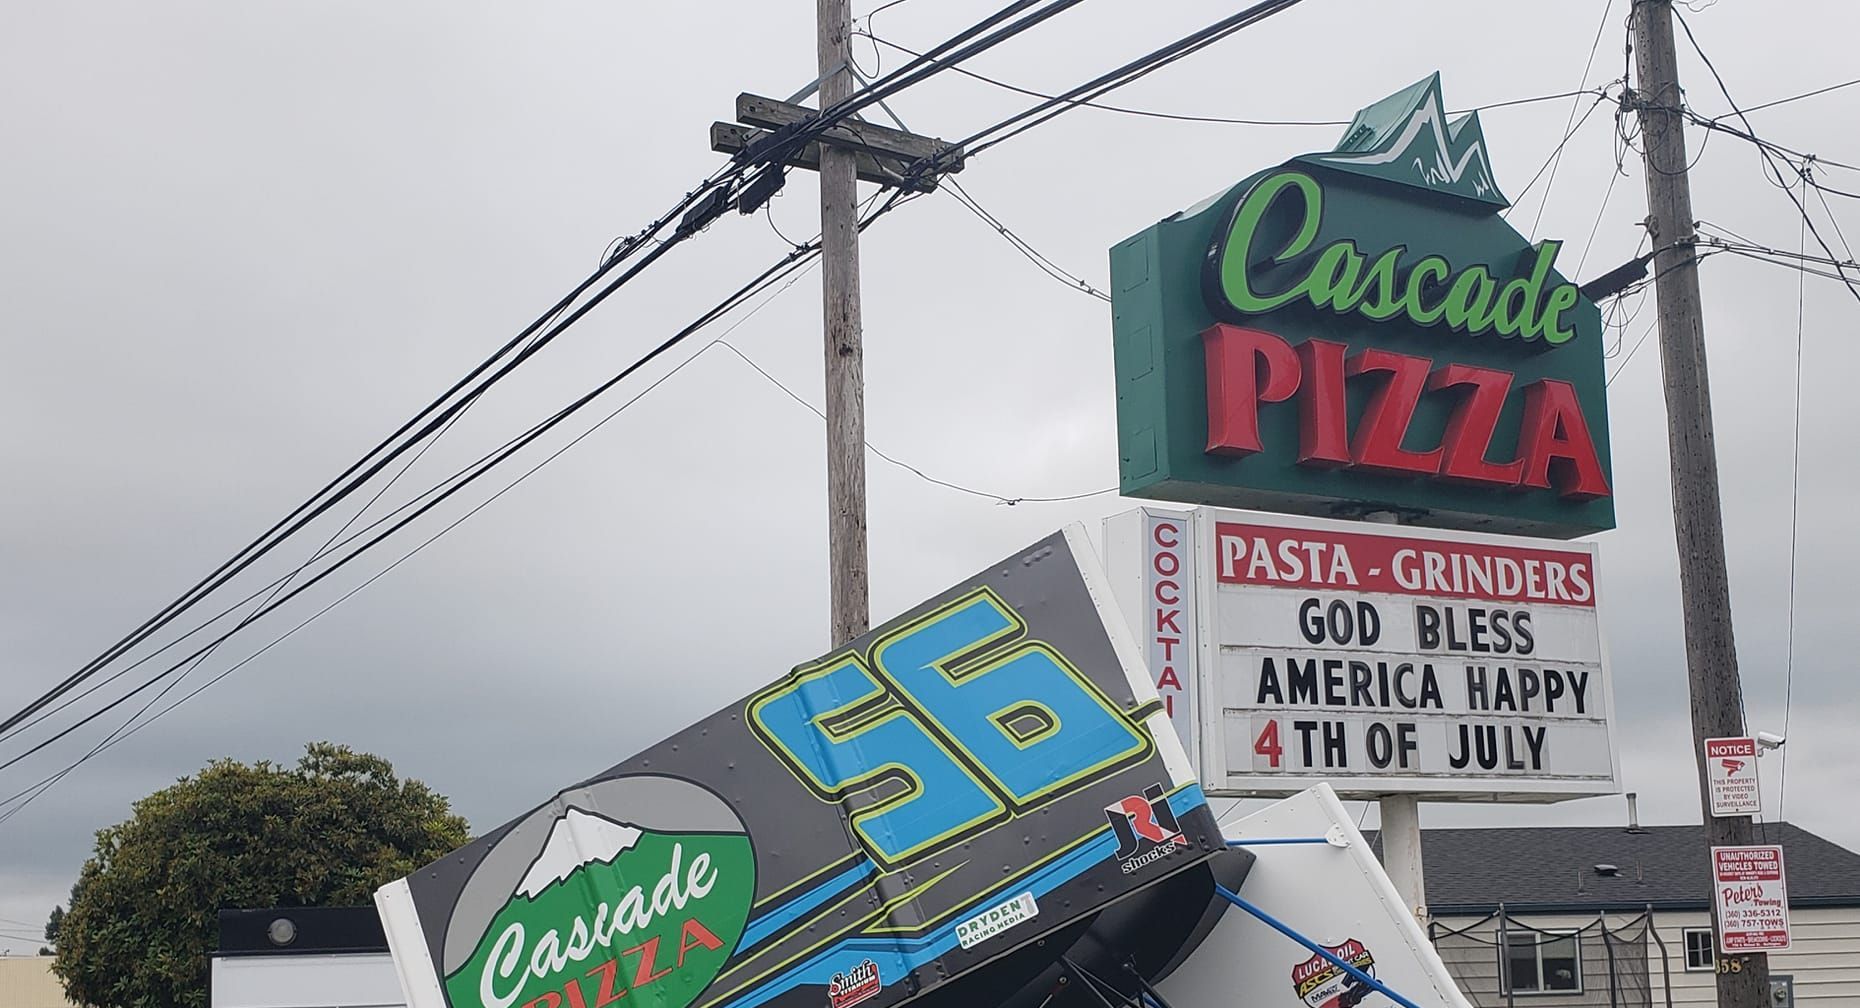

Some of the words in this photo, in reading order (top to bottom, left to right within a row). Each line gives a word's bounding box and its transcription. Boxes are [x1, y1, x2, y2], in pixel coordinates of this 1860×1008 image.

[1219, 171, 1579, 345] Cascade
[1203, 324, 1610, 498] PIZZA
[1219, 534, 1358, 586] PASTA
[1392, 548, 1591, 602] GRINDERS
[1300, 597, 1381, 646] GOD
[1416, 605, 1534, 655] BLESS
[1257, 657, 1444, 709] AMERICA
[1468, 665, 1589, 714] HAPPY
[747, 586, 1154, 873] 56
[1366, 722, 1417, 769] OF
[1449, 724, 1546, 771] JULY
[1711, 745, 1752, 755] NOTICE
[1722, 785, 1755, 793] PROTECTED
[1726, 777, 1756, 785] PROPERTY
[1731, 792, 1749, 800] VIDEO
[1716, 800, 1757, 808] SURVEILLANCE
[1121, 841, 1177, 874] shocks
[1718, 862, 1753, 872] VEHICLES
[1753, 861, 1779, 871] TOWED
[1720, 851, 1774, 861] UNAUTHORIZED
[958, 900, 1021, 937] DRYDEN
[1742, 909, 1781, 918] 336-5312
[1753, 898, 1781, 908] Towing
[962, 927, 996, 946] RACING
[997, 913, 1025, 929] MEDIA
[1741, 919, 1784, 927] 757-TOWS
[830, 959, 872, 996] Smith
[1298, 957, 1333, 980] LUCA
[1336, 944, 1356, 960] OIL
